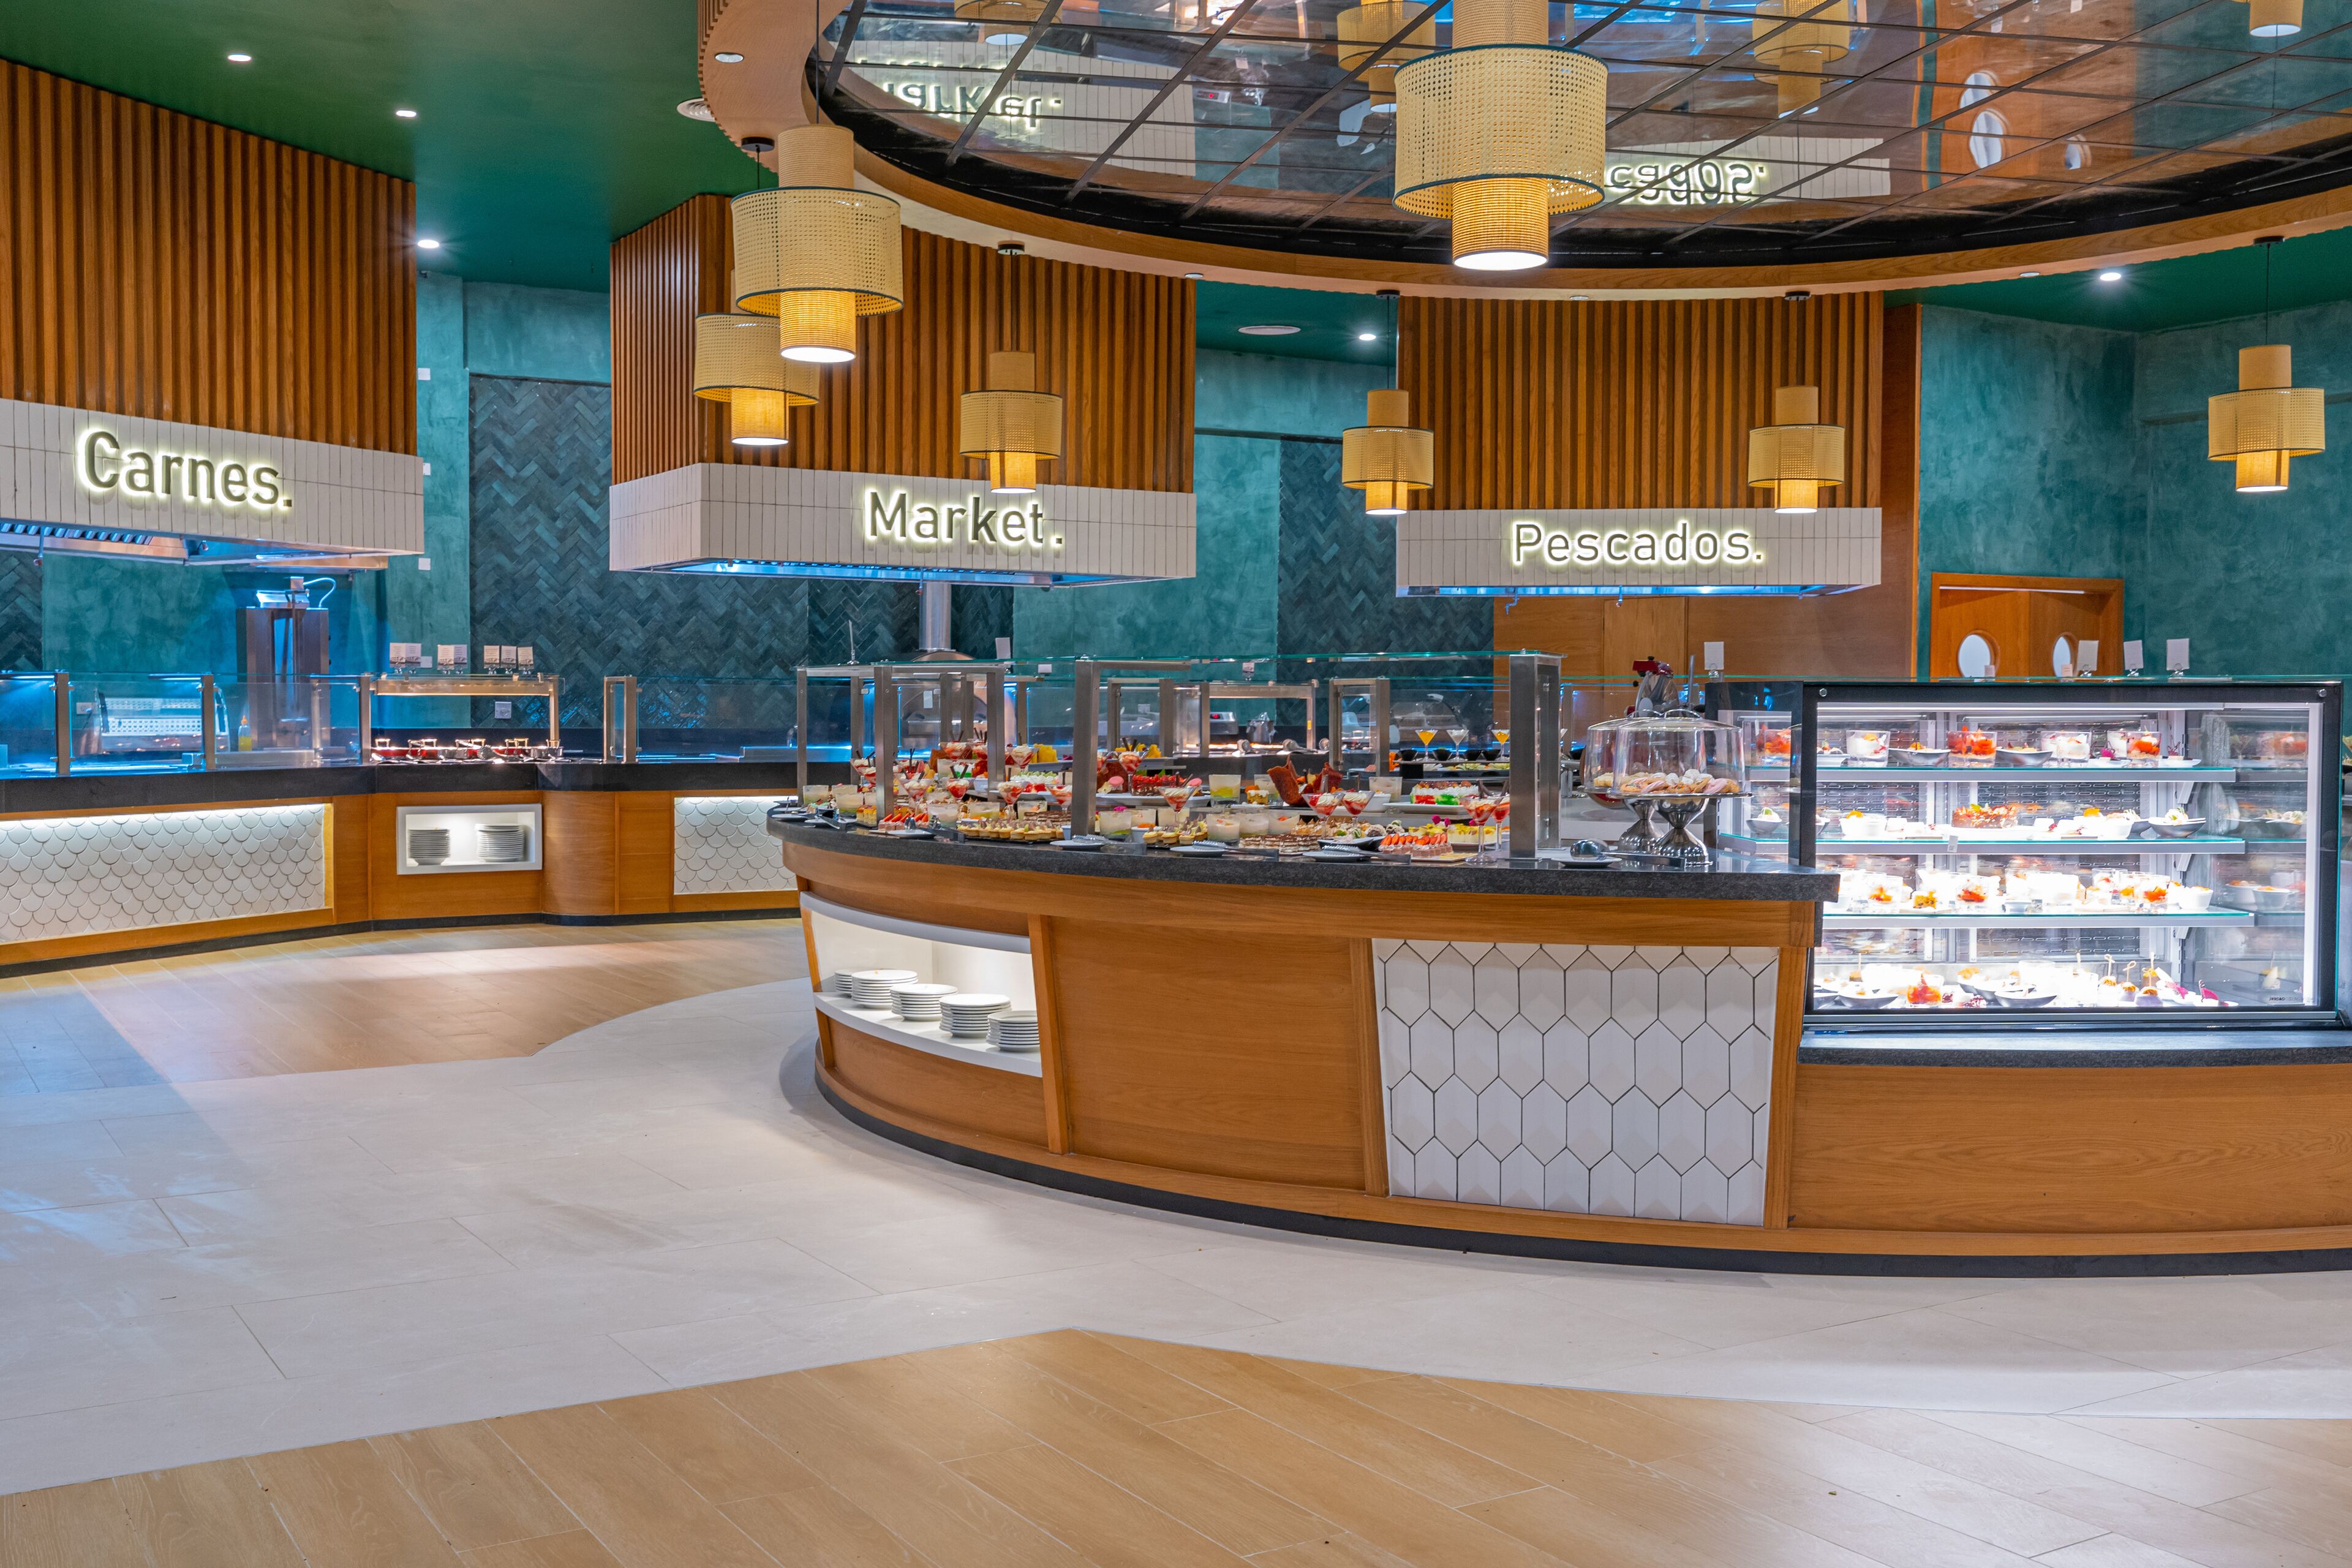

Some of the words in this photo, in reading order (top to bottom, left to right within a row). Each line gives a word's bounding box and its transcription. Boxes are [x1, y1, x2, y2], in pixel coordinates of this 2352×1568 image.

[85, 431, 292, 507] Carnes.
[870, 491, 1063, 545] Market.
[1515, 522, 1762, 562] Pescados.
